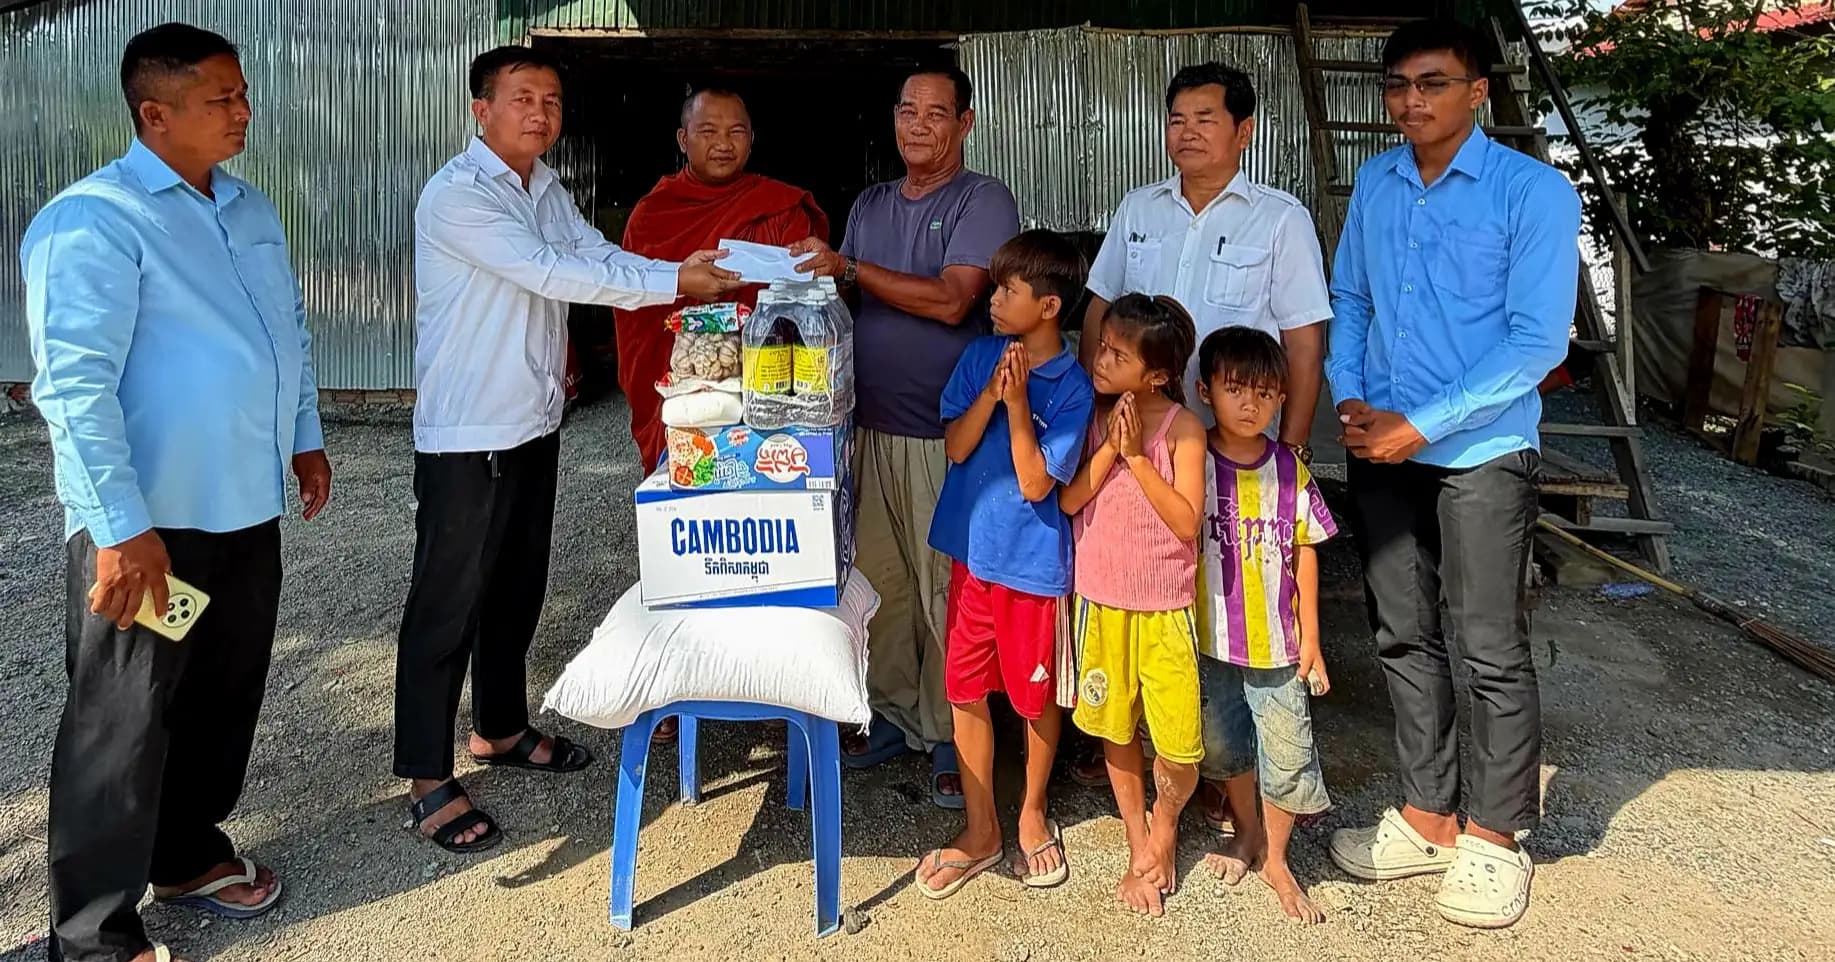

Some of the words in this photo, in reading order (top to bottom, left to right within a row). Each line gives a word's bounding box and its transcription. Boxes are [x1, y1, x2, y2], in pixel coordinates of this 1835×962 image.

[671, 516, 800, 557] CAMBODIA
[704, 557, 769, 583] ទឹកពិសាកម្ពុជា
